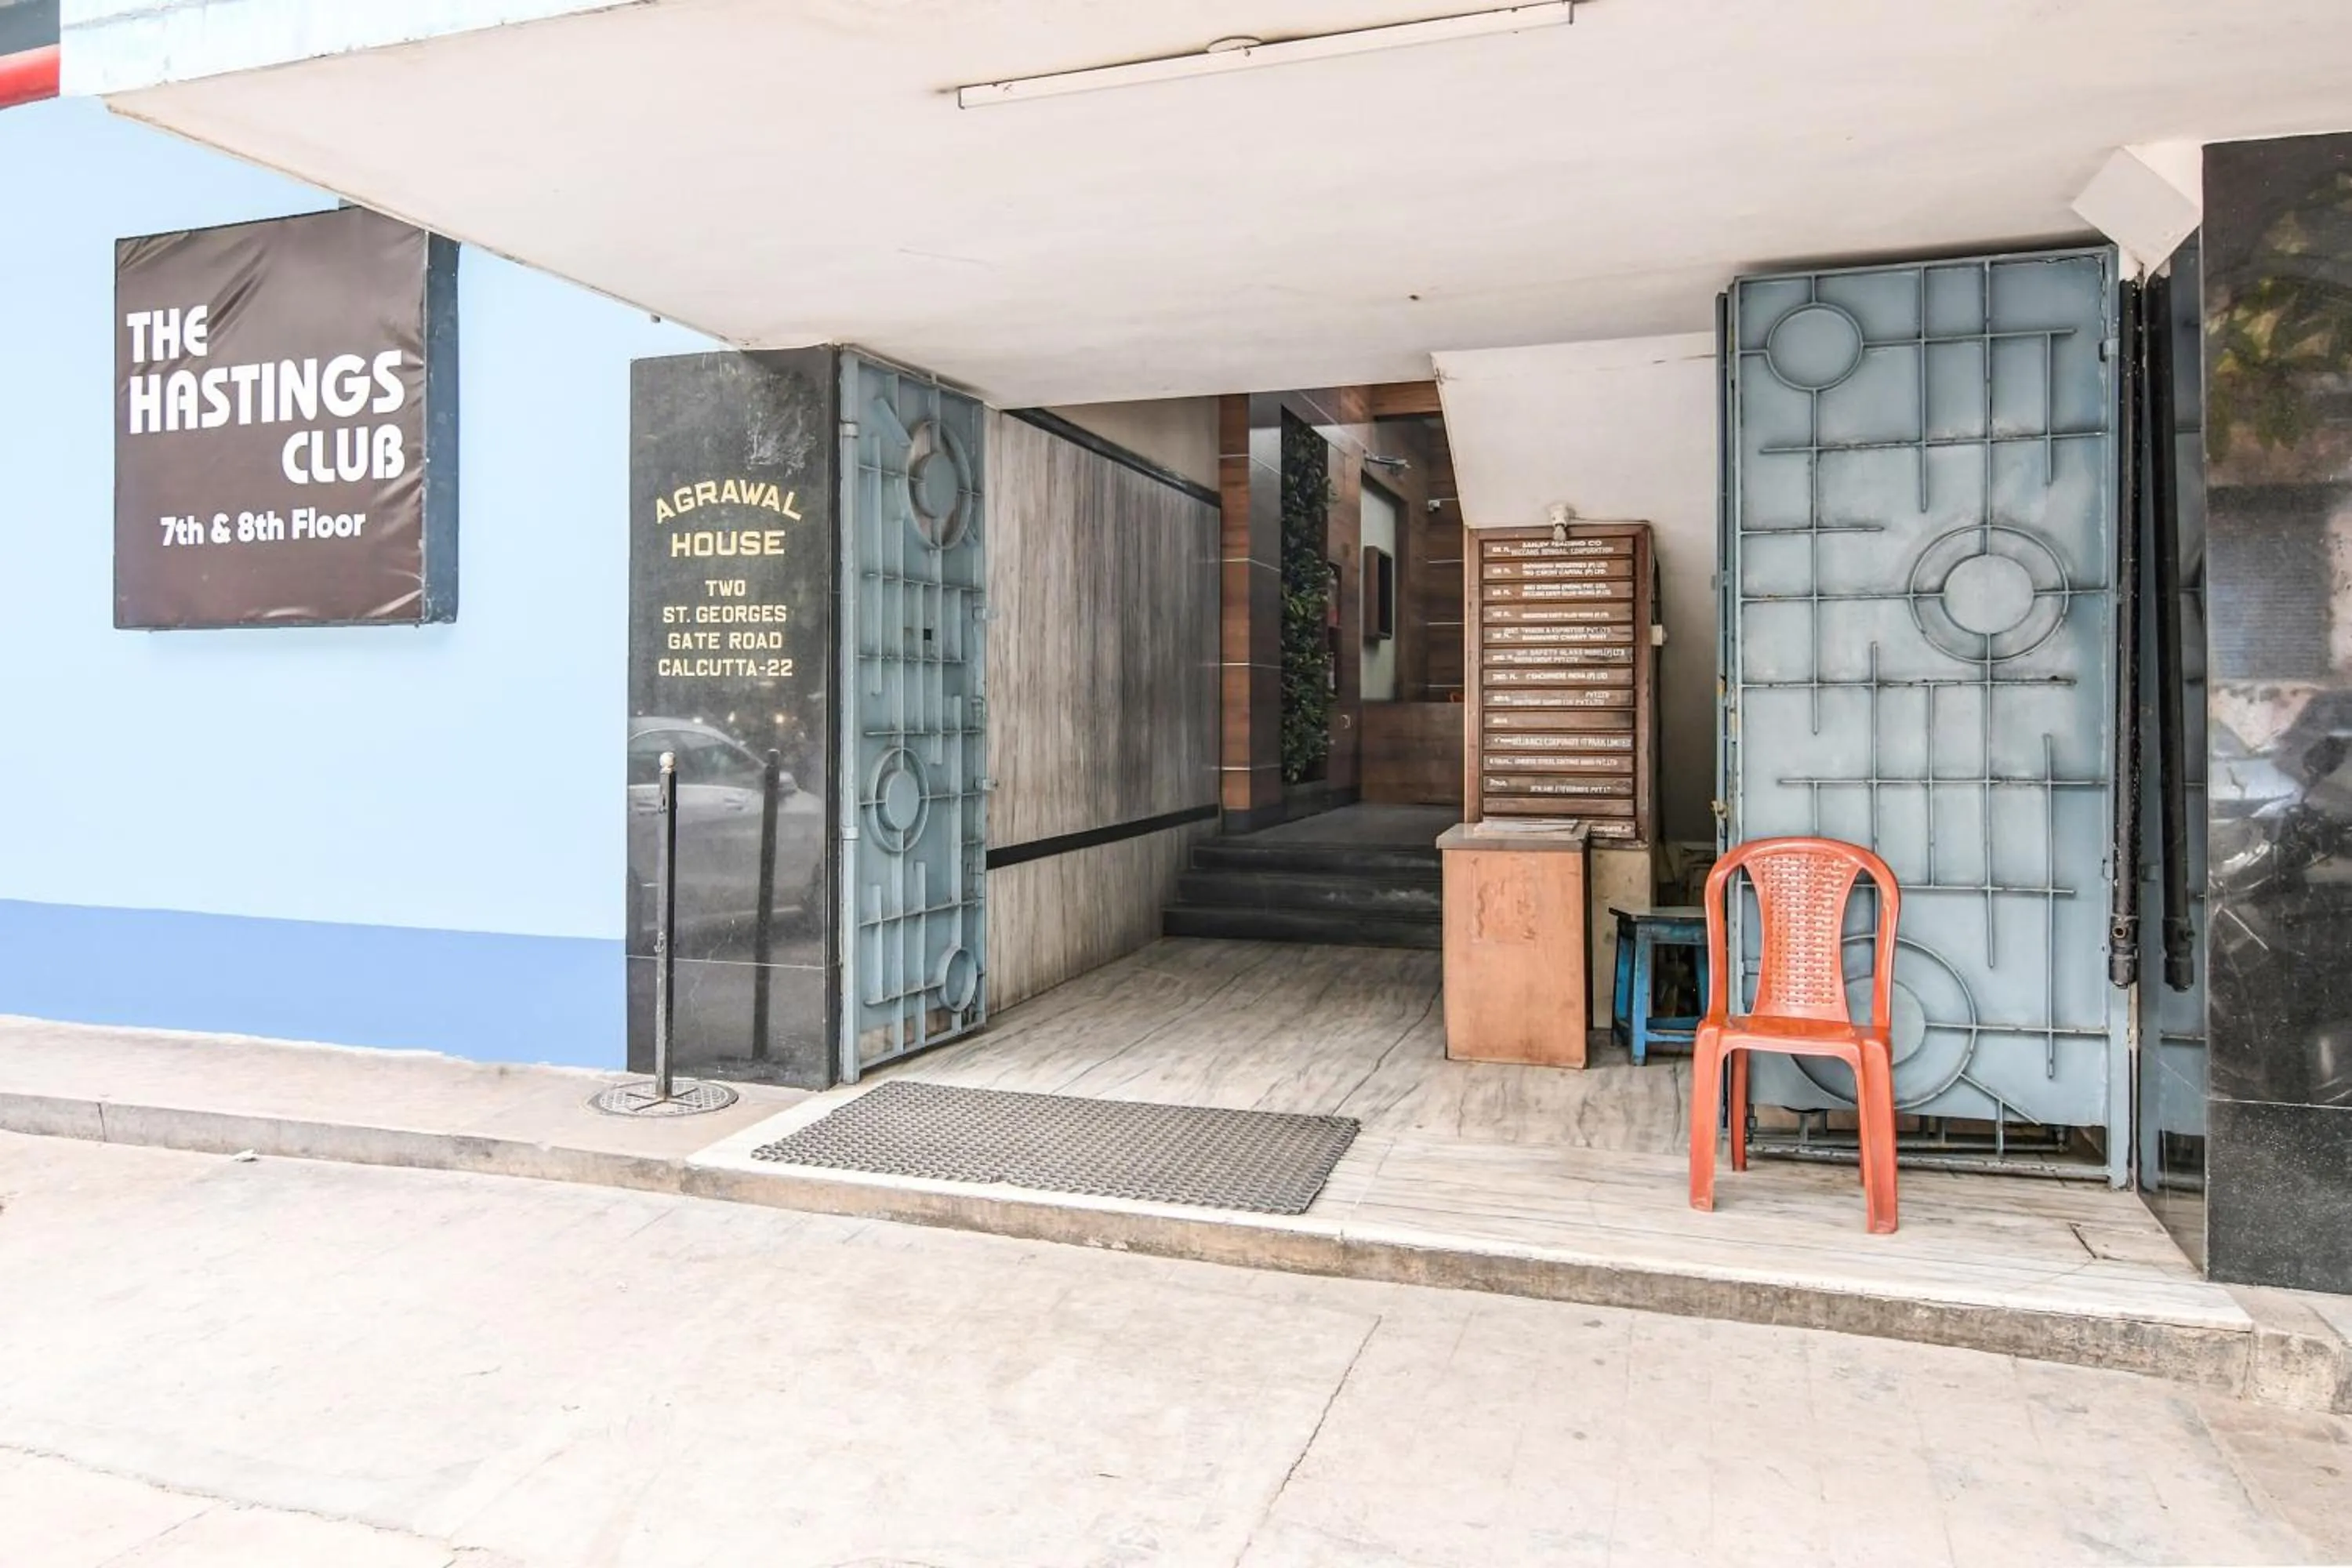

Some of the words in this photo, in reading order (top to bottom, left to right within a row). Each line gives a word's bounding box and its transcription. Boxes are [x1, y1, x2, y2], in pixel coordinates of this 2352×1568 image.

[126, 305, 208, 363] THE
[129, 350, 405, 434] HASTINGS
[281, 423, 405, 485] CLUB
[655, 479, 802, 524] AGRAWAL
[160, 514, 204, 546] 7th
[210, 512, 231, 544] &
[237, 510, 285, 543] 8th
[291, 506, 366, 540] Floor
[670, 530, 786, 557] HOUSE
[705, 579, 746, 597] TWO
[662, 606, 691, 623] ST.
[695, 604, 786, 623] GEORGES
[668, 633, 720, 650] GATE
[728, 632, 782, 649] ROAD
[658, 658, 793, 677] CALCUTTA-22
